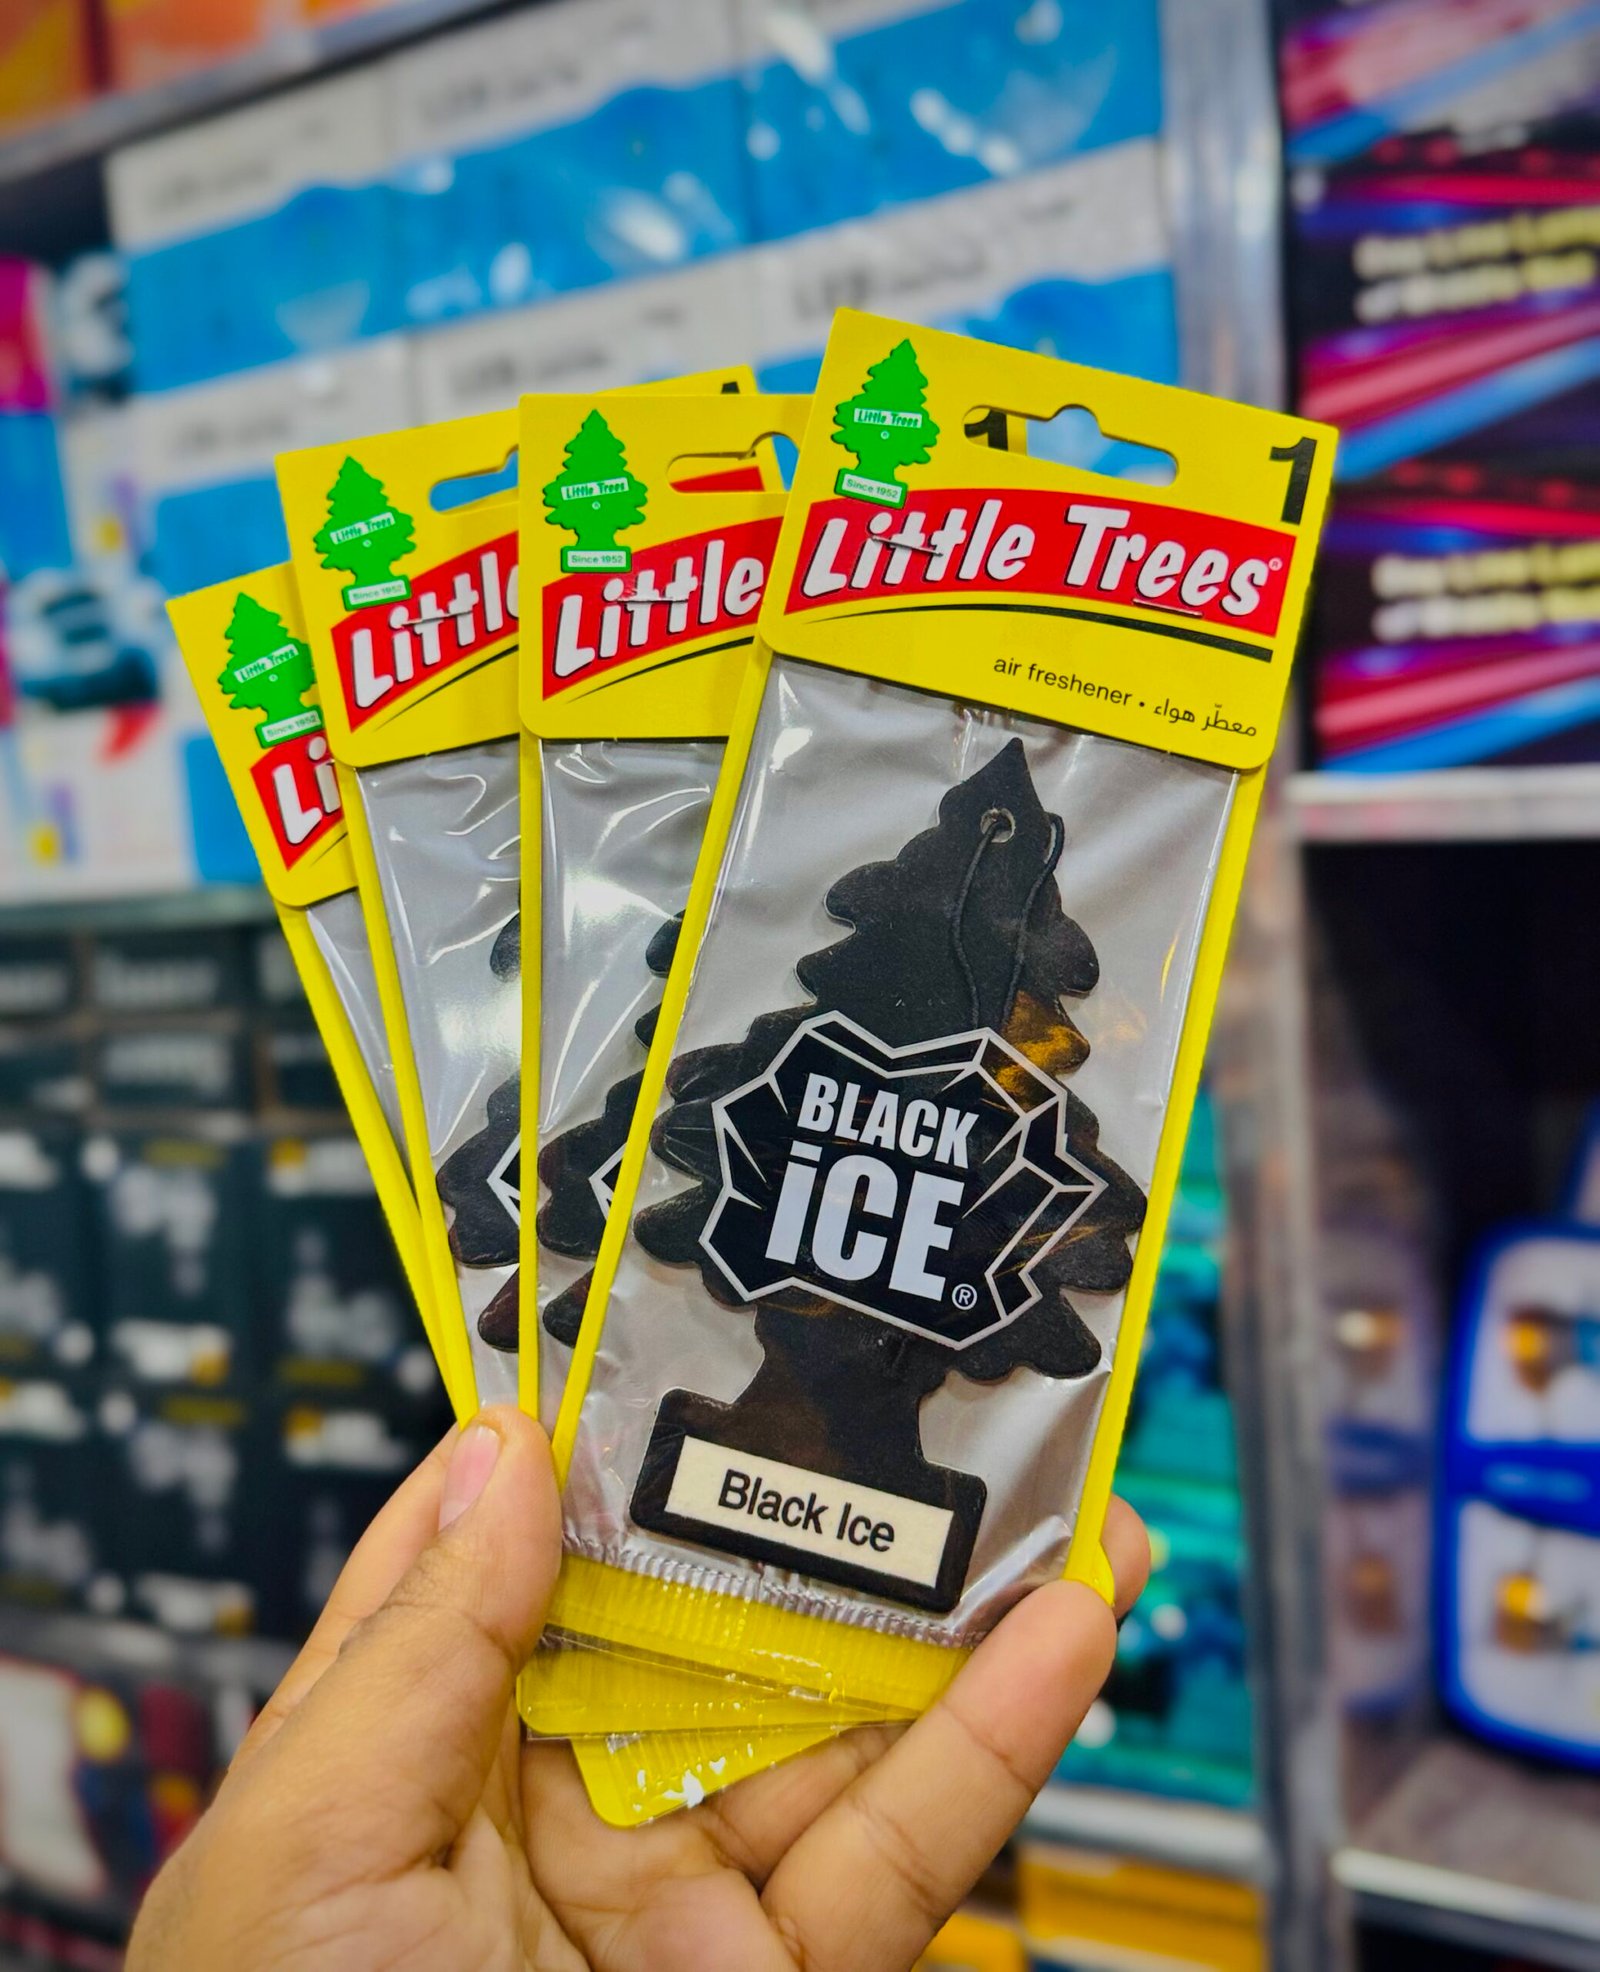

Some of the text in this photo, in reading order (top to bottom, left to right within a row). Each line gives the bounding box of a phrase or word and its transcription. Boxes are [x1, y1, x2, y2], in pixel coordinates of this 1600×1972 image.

[857, 410, 919, 427] Little Trees
[565, 481, 626, 499] Little Trees
[846, 478, 898, 499] Since 1952
[1269, 436, 1317, 525] 1
[335, 516, 392, 543] Little Trees
[571, 554, 623, 565] Since 1952
[803, 499, 1036, 597] Little
[554, 539, 764, 677] Little
[239, 648, 297, 683] Little Trees
[993, 657, 1133, 707] air freshener
[1153, 698, 1196, 723] هواء
[797, 1072, 979, 1169] BLACK
[718, 1469, 894, 1552] Black Ice
